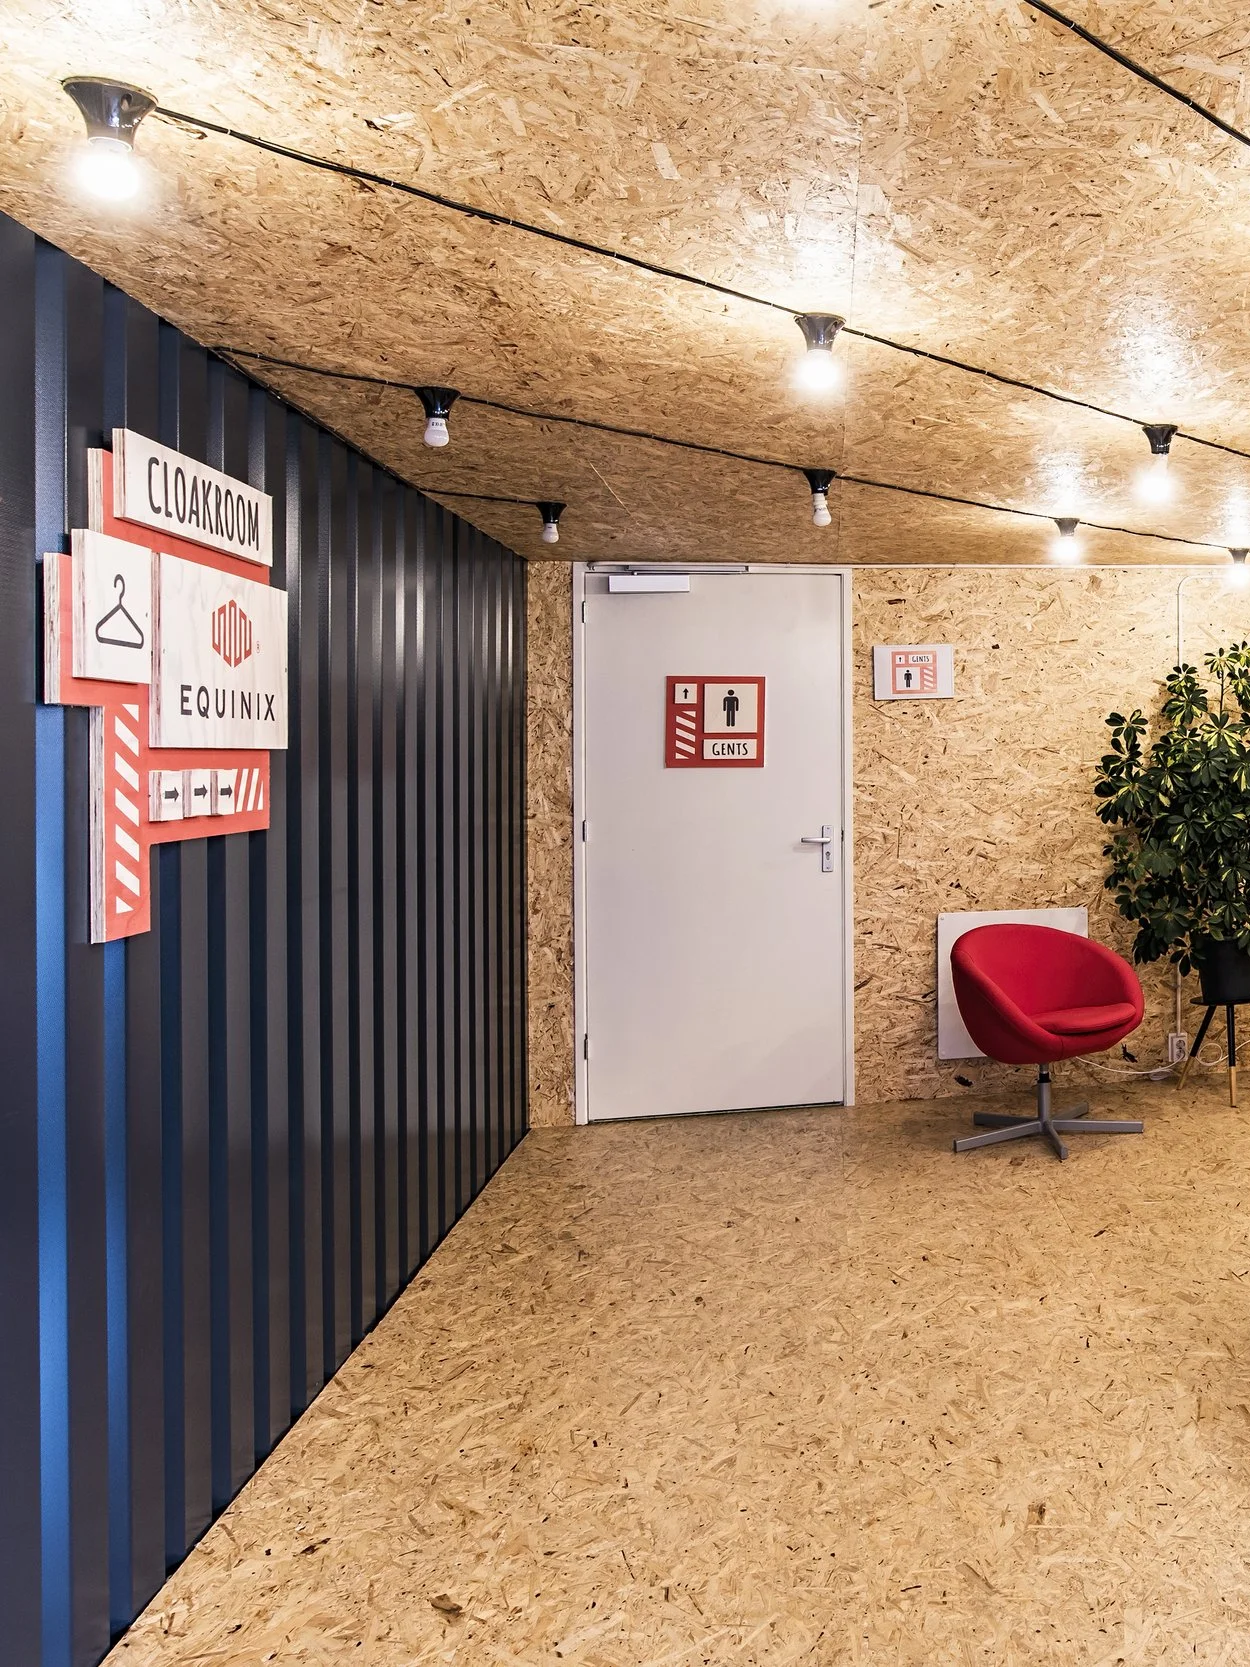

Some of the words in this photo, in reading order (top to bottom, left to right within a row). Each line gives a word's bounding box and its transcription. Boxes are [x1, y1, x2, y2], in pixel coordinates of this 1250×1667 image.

[147, 456, 260, 551] CLOAKROOM
[912, 655, 930, 663] GENTS
[180, 684, 276, 722] EQUINIX
[712, 742, 748, 756] GENTS
